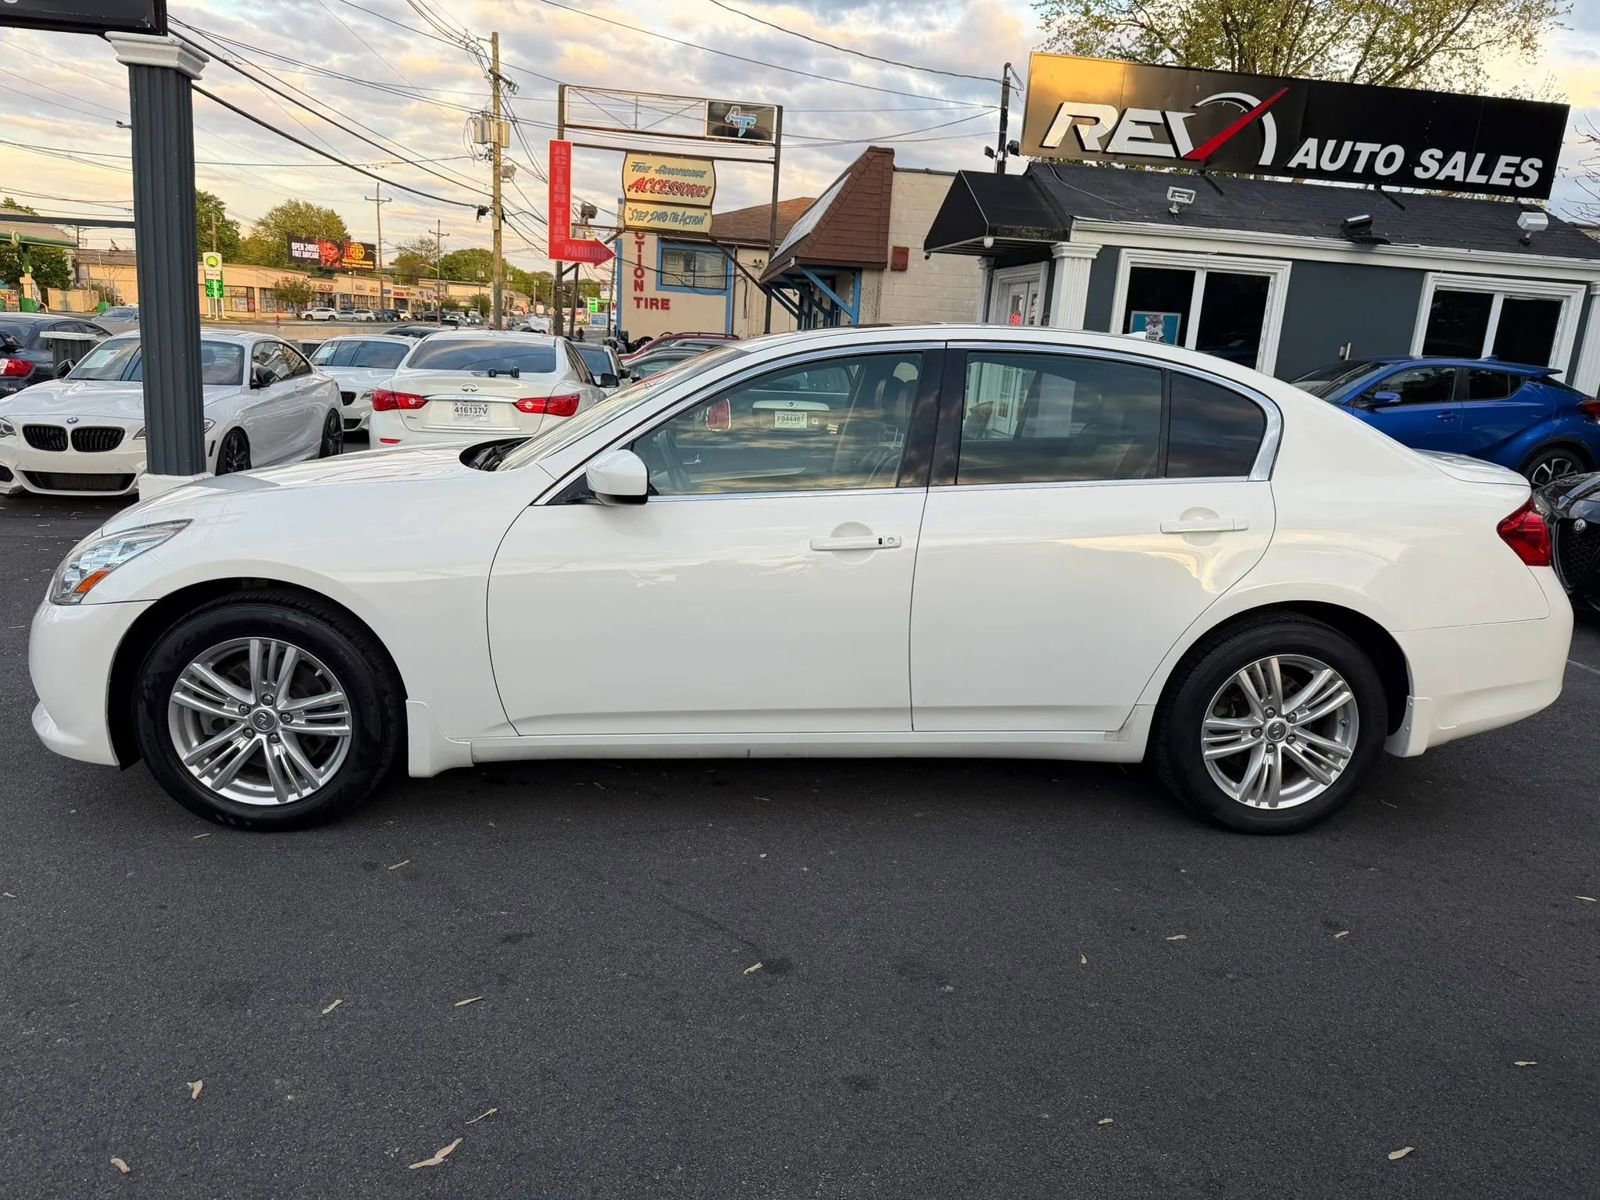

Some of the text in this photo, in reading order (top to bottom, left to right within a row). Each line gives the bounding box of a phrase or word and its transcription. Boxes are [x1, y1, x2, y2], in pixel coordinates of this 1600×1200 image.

[1287, 137, 1543, 188] AUTO SALES
[552, 146, 567, 244] ACTION TIRE
[627, 176, 711, 198] ACCESSORIES
[564, 244, 608, 259] PARKING
[633, 297, 670, 310] TIRE
[454, 406, 488, 414] 416137V
